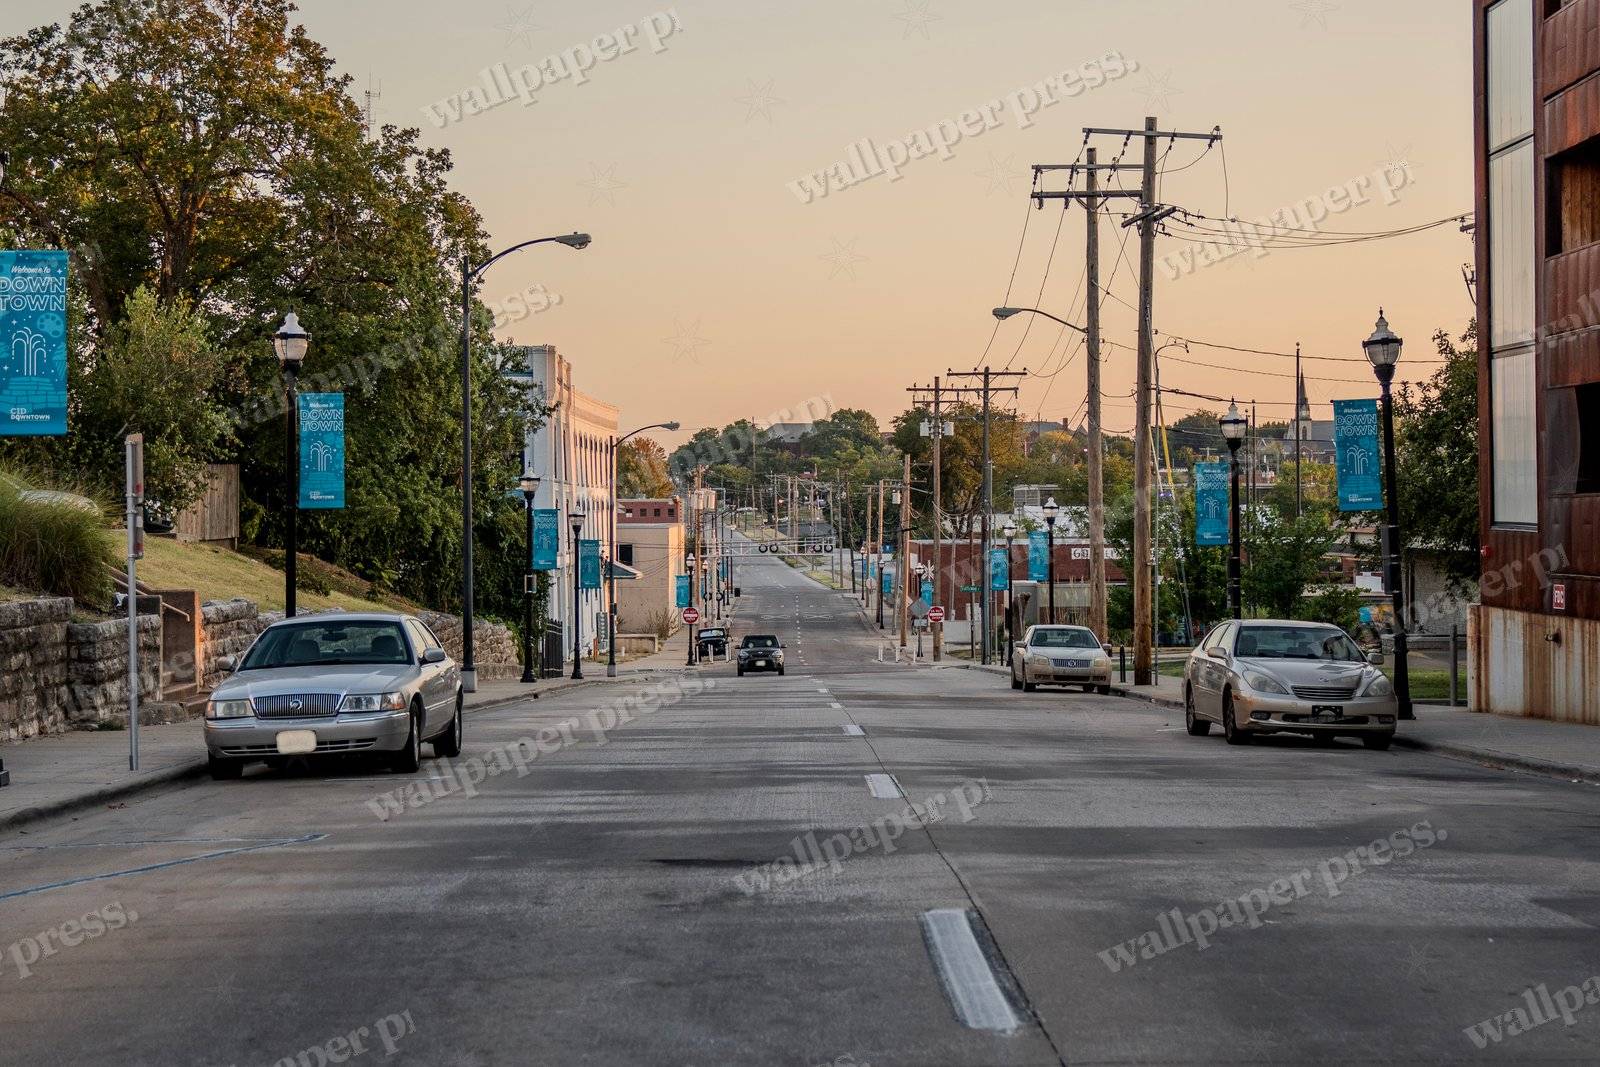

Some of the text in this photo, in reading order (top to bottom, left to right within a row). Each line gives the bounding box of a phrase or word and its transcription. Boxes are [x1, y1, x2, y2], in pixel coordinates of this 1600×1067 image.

[11, 265, 43, 274] Welcome
[0, 276, 66, 293] DOWN
[0, 294, 66, 312] TOWN
[10, 407, 27, 415] CID
[300, 409, 344, 421] DOWN
[1335, 413, 1377, 426] DOWN
[300, 420, 344, 432] TOWN
[1335, 424, 1378, 437] TOWN
